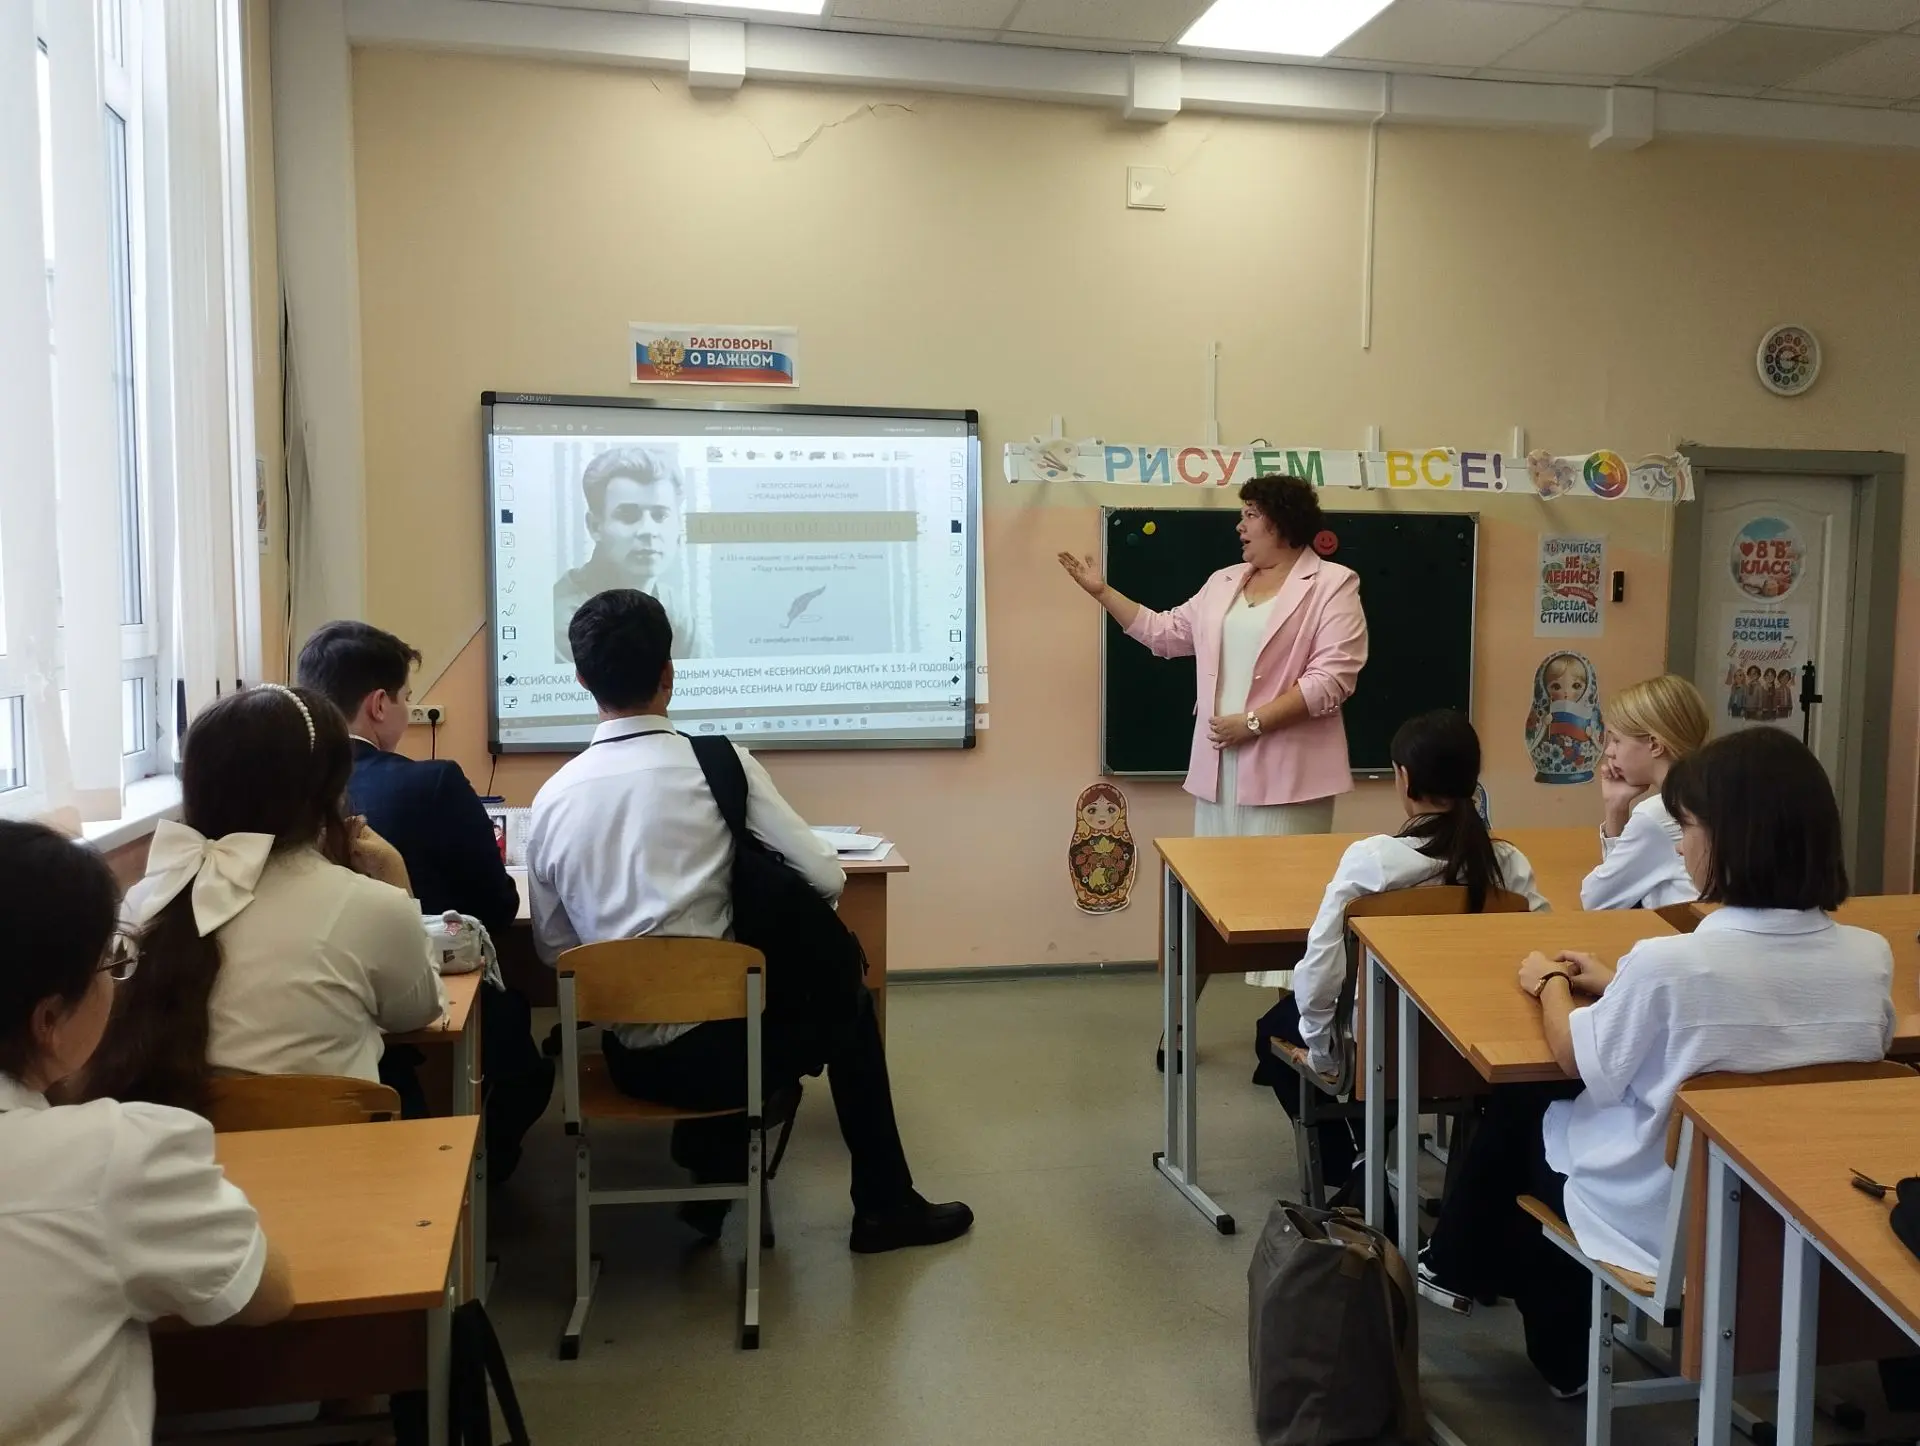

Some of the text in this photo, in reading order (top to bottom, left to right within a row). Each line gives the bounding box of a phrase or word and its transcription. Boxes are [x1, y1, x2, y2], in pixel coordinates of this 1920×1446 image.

[690, 337, 773, 350] РАЗГОВОРЫ
[690, 352, 774, 367] О ВАЖНОМ
[1104, 445, 1504, 489] РИСУЕМ ВСЕ!
[1546, 542, 1601, 554] ТЫ УЧИТЬСЯ
[1756, 540, 1767, 559] 8
[1565, 556, 1580, 568] НЕ
[1740, 560, 1791, 575] КЛАСС
[1552, 600, 1587, 611] ВСЕГДА
[1541, 611, 1599, 624] СТРЕМИСЬ!
[1735, 617, 1790, 629] БУДУЩЕЕ
[1732, 630, 1782, 641] РОССИИ
[713, 667, 762, 679] УЧАСТИЕМ
[764, 664, 831, 677] «ЕСЕНИНСКИЙ
[833, 664, 880, 675] ДИКТАНТ»
[882, 664, 889, 673] К
[891, 662, 917, 673] 131-Й
[740, 683, 784, 694] ЕСЕНИНА
[786, 683, 792, 692] И
[795, 682, 817, 693] ГОДУ
[820, 680, 868, 692] ЕДИНСТВА
[870, 679, 913, 690] НАРОДОВ
[531, 693, 552, 703] ДНЯ
